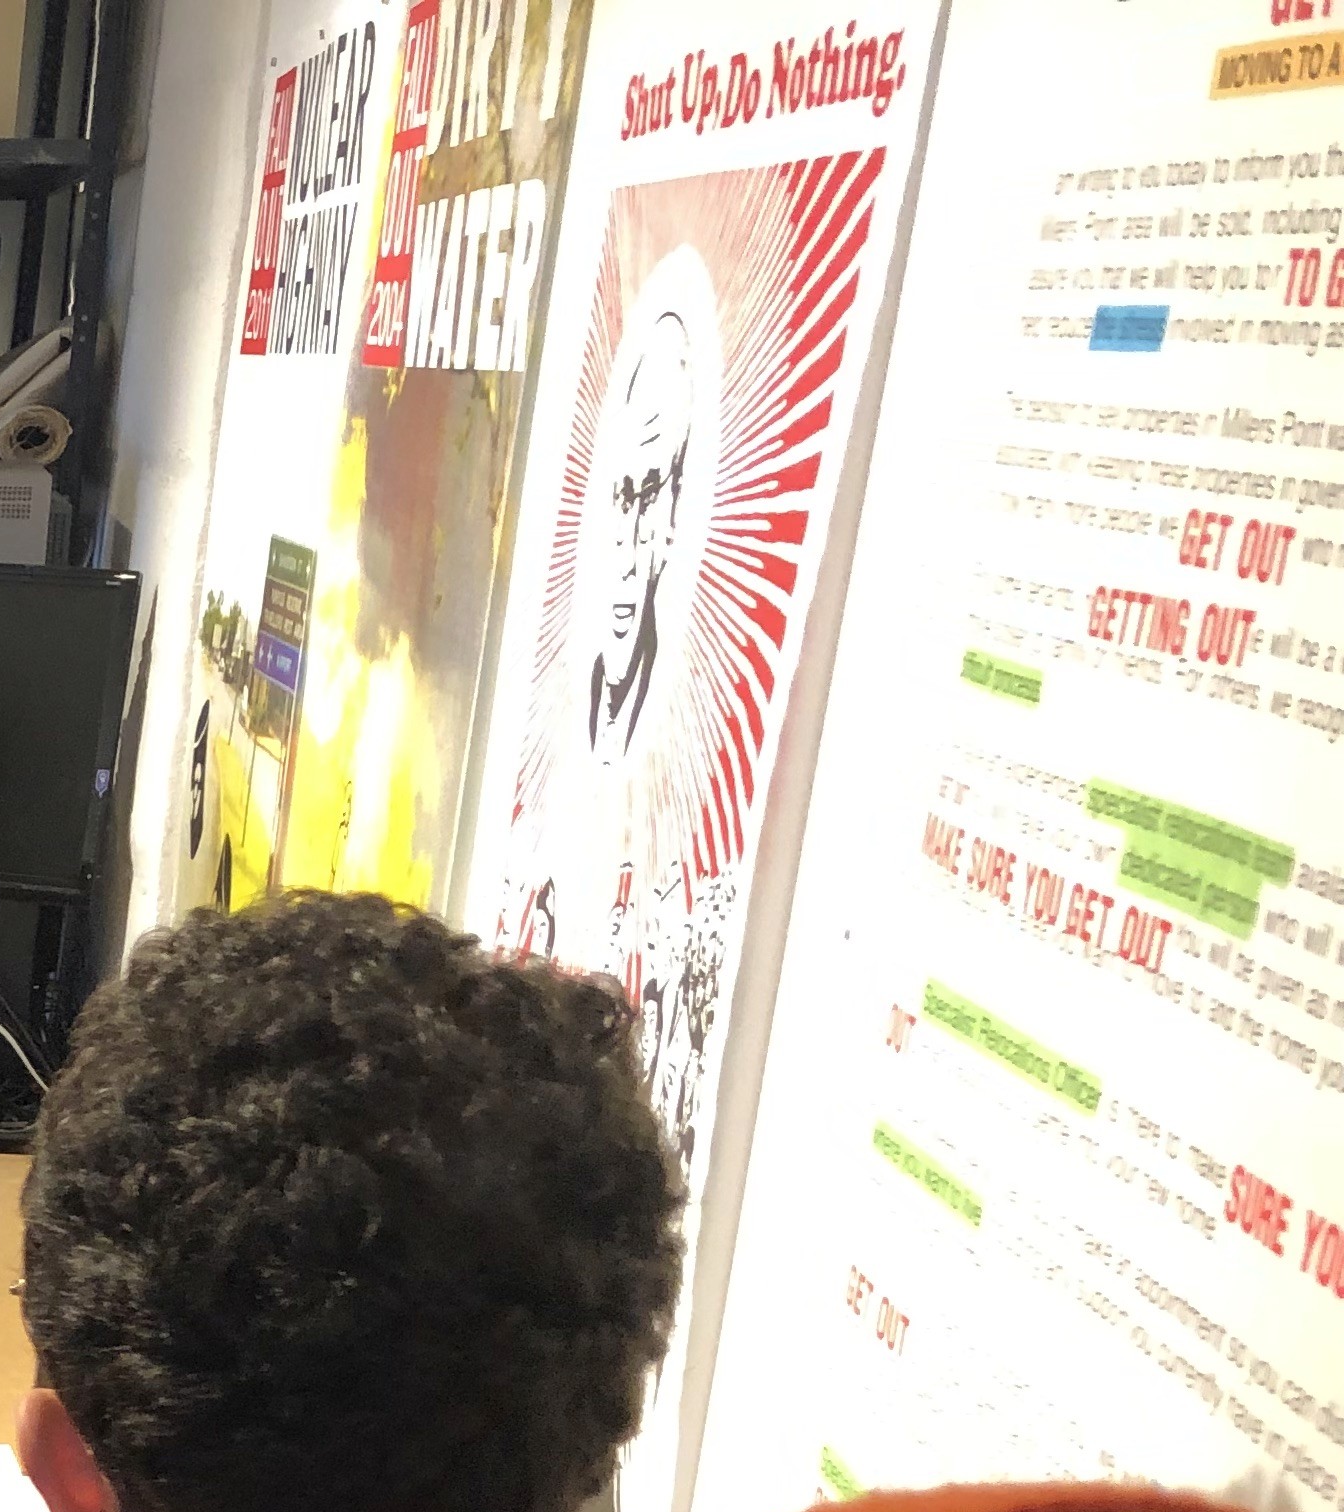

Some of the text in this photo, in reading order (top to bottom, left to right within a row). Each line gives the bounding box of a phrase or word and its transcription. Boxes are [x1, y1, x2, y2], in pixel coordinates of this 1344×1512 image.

[396, 14, 436, 133] FALL
[1298, 43, 1324, 80] TO
[287, 20, 376, 205] NUCLEAR
[621, 67, 676, 141] Shut
[254, 185, 283, 271] OUT
[381, 147, 424, 258] OUT
[245, 287, 272, 340] 2011
[269, 202, 358, 354] HIGHWAY
[367, 280, 408, 347] 2004
[405, 178, 546, 371] WATER
[1283, 247, 1321, 307] TO
[1179, 508, 1234, 571] GET
[1237, 518, 1298, 585] OUT
[1087, 585, 1191, 656] GETTING
[1197, 603, 1258, 667] OUT
[922, 811, 965, 876] MAKE
[967, 836, 1016, 906] SURE
[1023, 861, 1065, 926] YOU
[1065, 882, 1115, 949] GET
[1118, 905, 1172, 974] OUT
[1223, 1164, 1295, 1258] SURE
[876, 1297, 910, 1357] OUT
